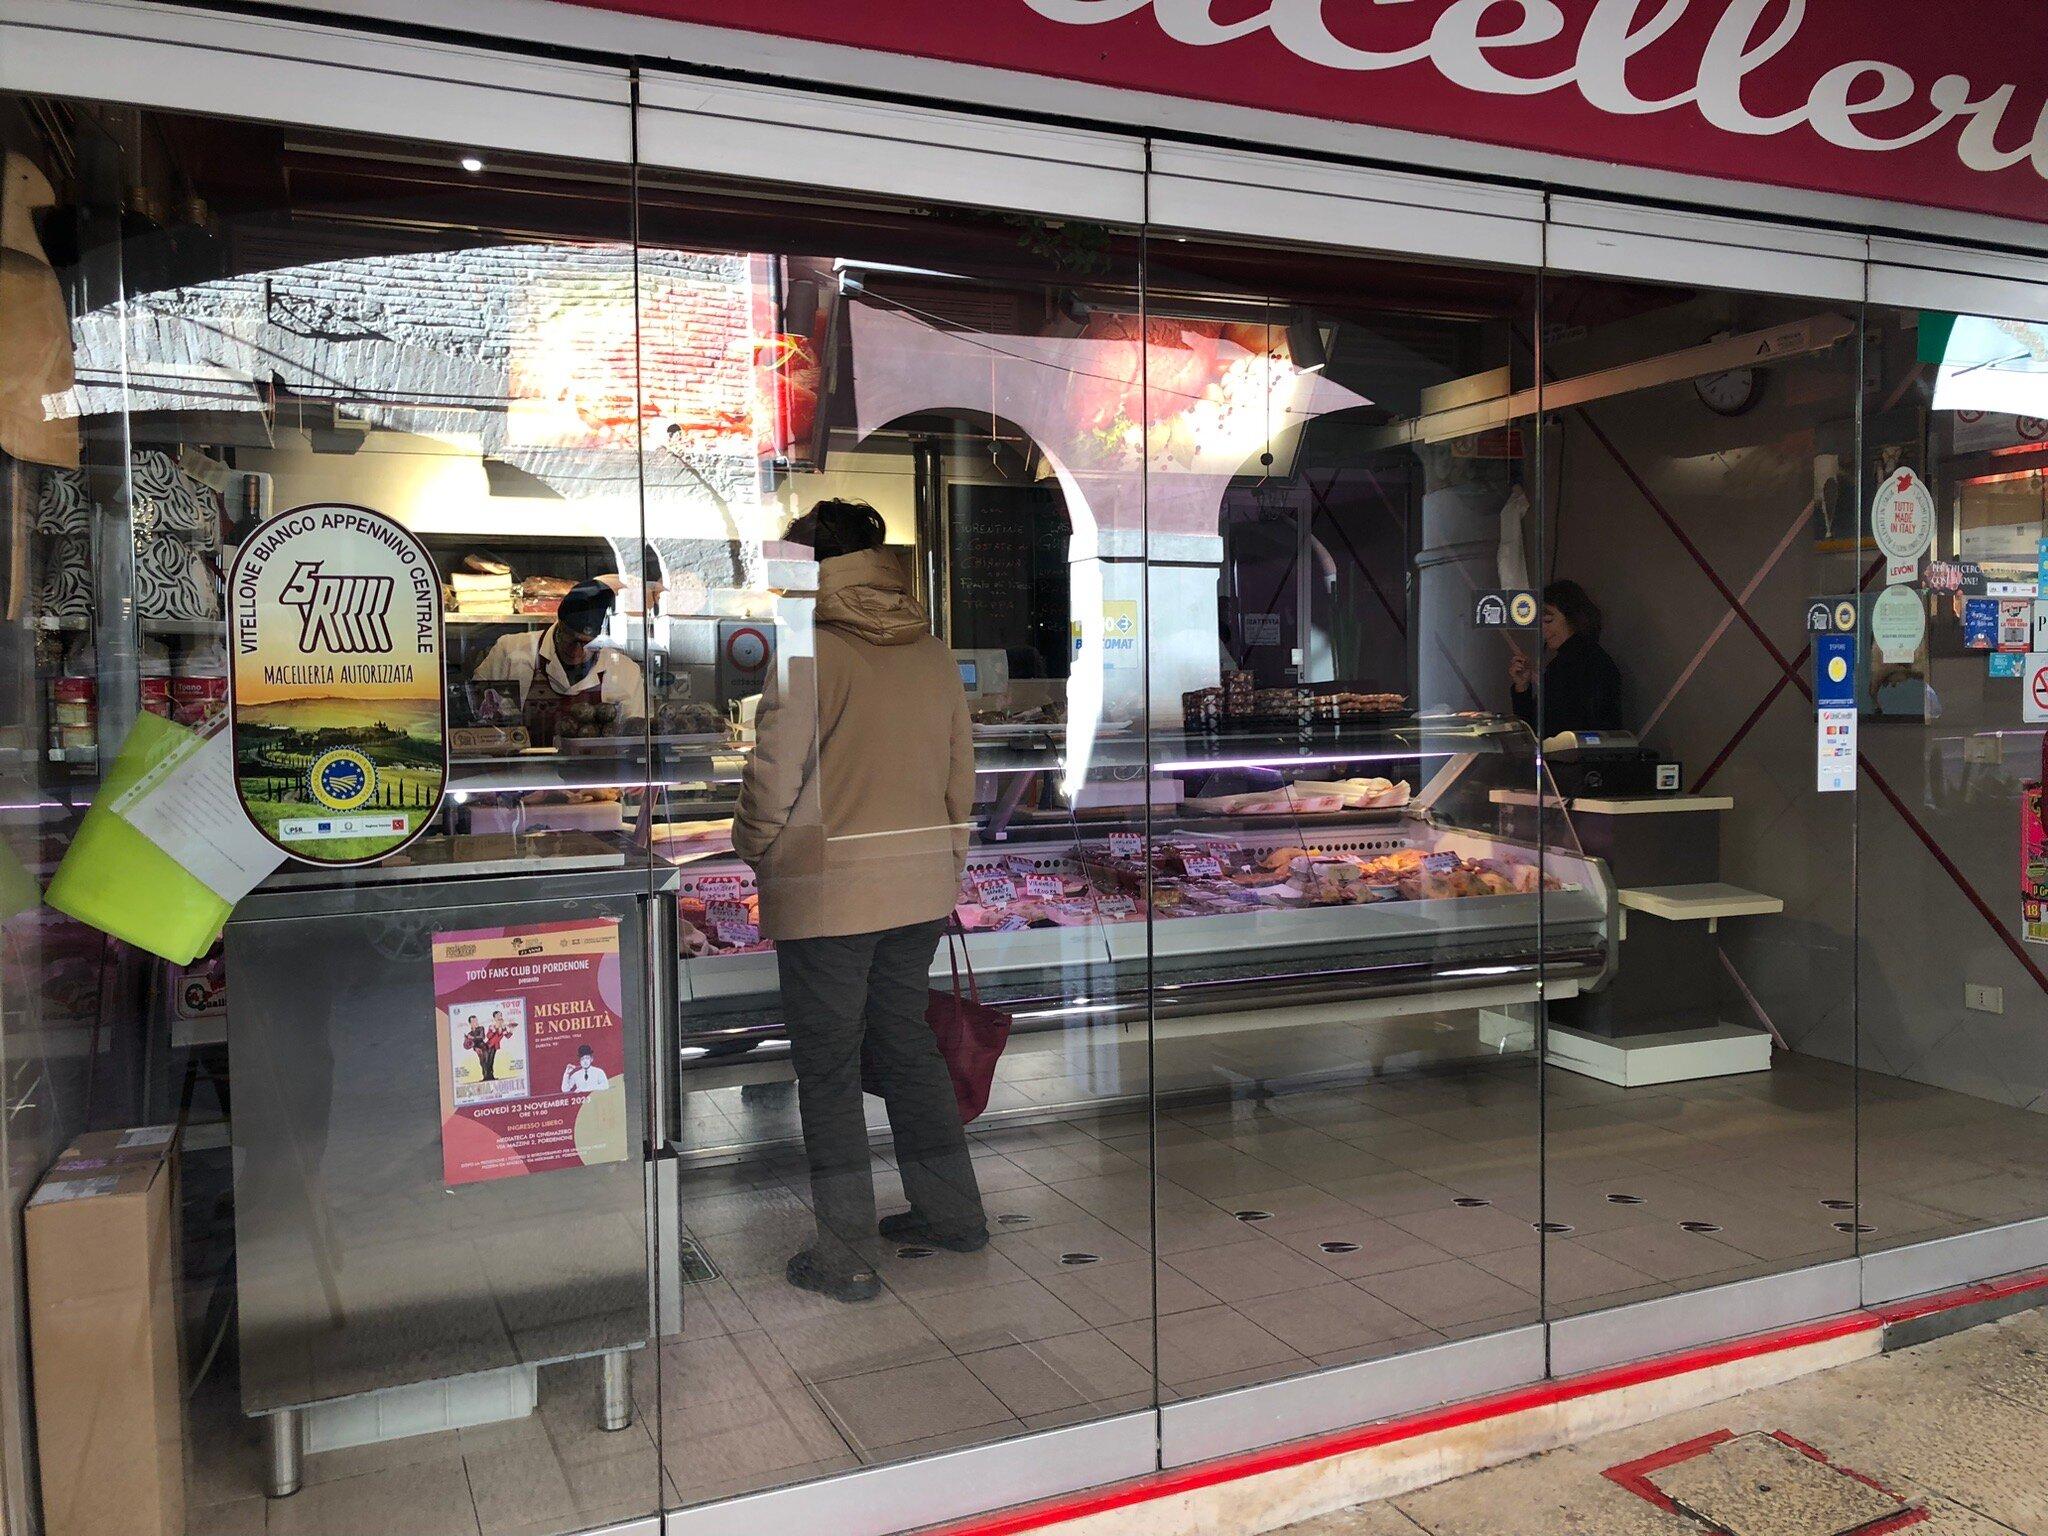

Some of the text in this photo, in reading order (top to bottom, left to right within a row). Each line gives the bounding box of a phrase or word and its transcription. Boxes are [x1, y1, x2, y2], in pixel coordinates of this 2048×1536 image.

[1023, 0, 2048, 181] celler
[1894, 501, 1914, 512] TUTTO
[1895, 512, 1913, 523] MADE
[1891, 523, 1916, 534] IN ITALY
[1890, 565, 1914, 576] LEVONI
[239, 514, 433, 654] VITELLONE BIANCO APPENNINO CENTRALE
[264, 664, 413, 685] MACELLERIA AUTORIZZATA
[2027, 904, 2038, 916] 18
[466, 959, 590, 981] TOTÒ FANS CLUB DI PORDENONE
[534, 1000, 595, 1018] MISERIA
[535, 1011, 613, 1035] E NOBILTÀ
[474, 1104, 510, 1118] GIOVEDÌ
[512, 1104, 522, 1113] 23
[524, 1098, 569, 1111] NOVEMBRE
[507, 1118, 563, 1132] INGRESSO LIBERO
[496, 1133, 528, 1143] MEDIATECA
[536, 1128, 572, 1138] CINEMAZERO
[507, 1140, 530, 1149] MAZZINI
[538, 1135, 573, 1144] PORDENONE
